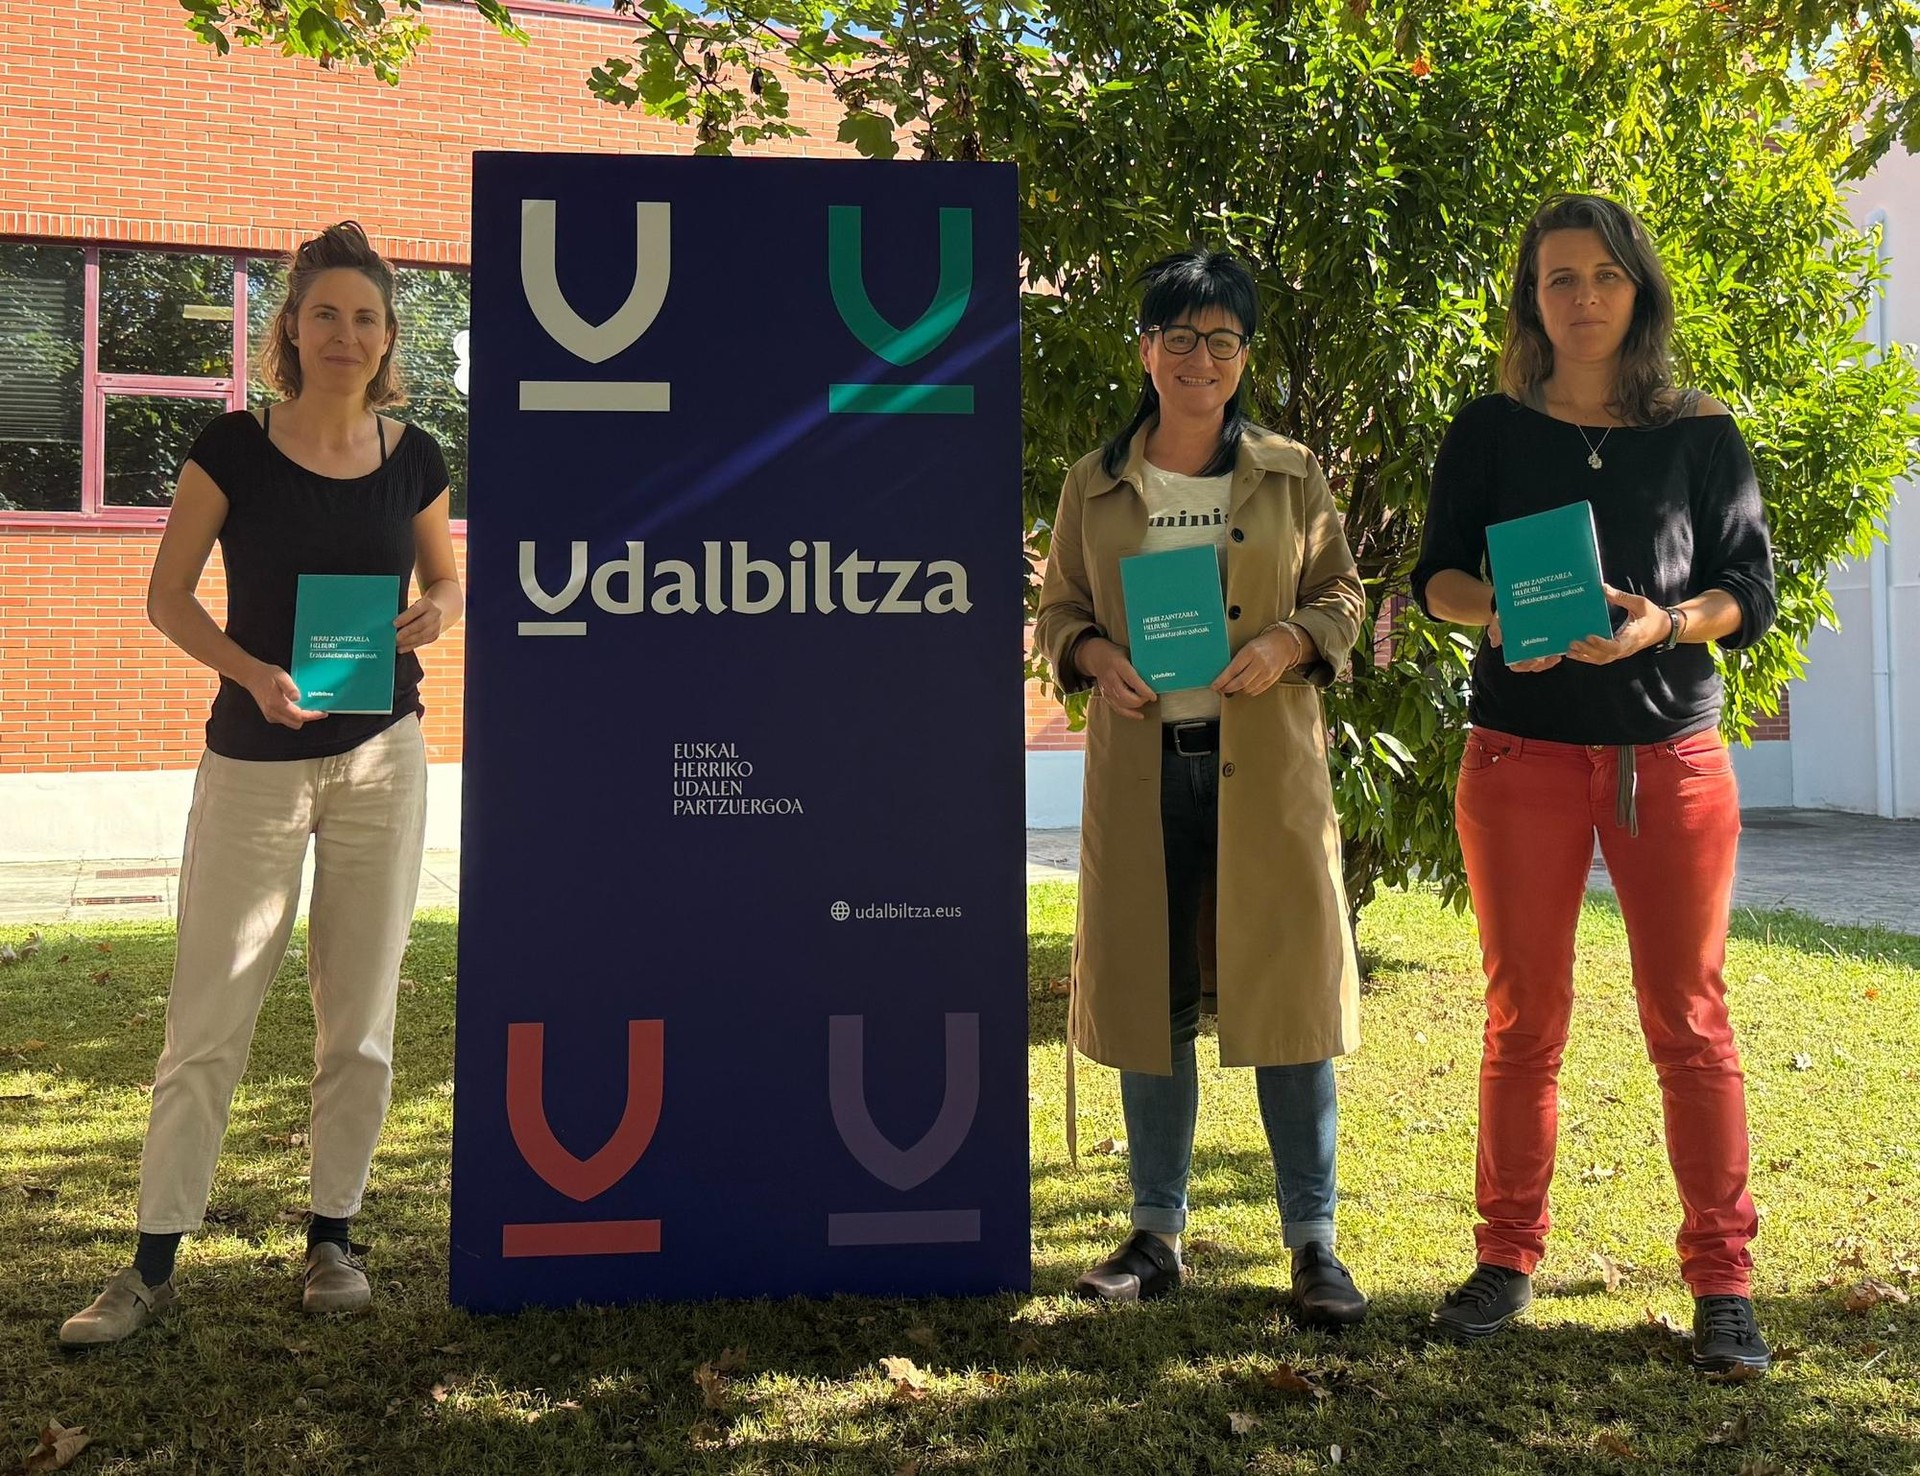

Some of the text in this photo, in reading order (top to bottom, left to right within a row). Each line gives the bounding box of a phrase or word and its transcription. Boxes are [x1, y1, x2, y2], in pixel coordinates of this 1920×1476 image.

[518, 540, 973, 617] Udalbiltza
[673, 742, 740, 760] EUSKAL
[673, 760, 754, 779] HERRIKO
[673, 779, 743, 797] UDALEN
[673, 797, 804, 816] PARTZUERGOA
[854, 902, 963, 920] udalbiltza.eus
